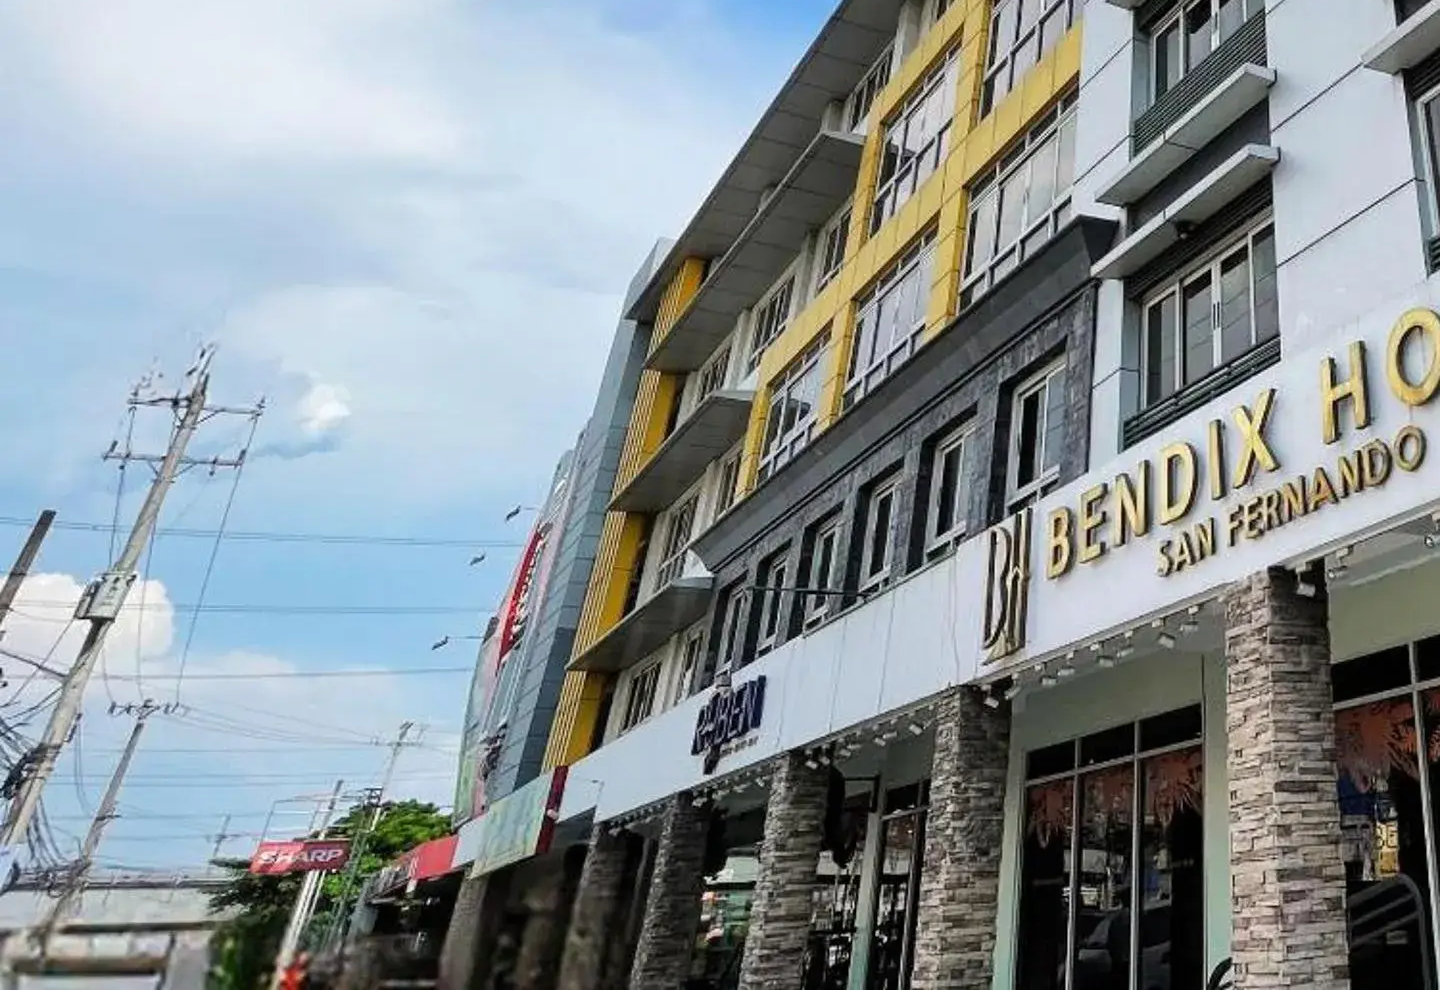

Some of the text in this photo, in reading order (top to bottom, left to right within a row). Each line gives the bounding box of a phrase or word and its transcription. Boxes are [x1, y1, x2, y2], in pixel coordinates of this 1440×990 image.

[1046, 388, 1281, 580] BENDIX
[1158, 424, 1427, 577] SAN FERNANDO
